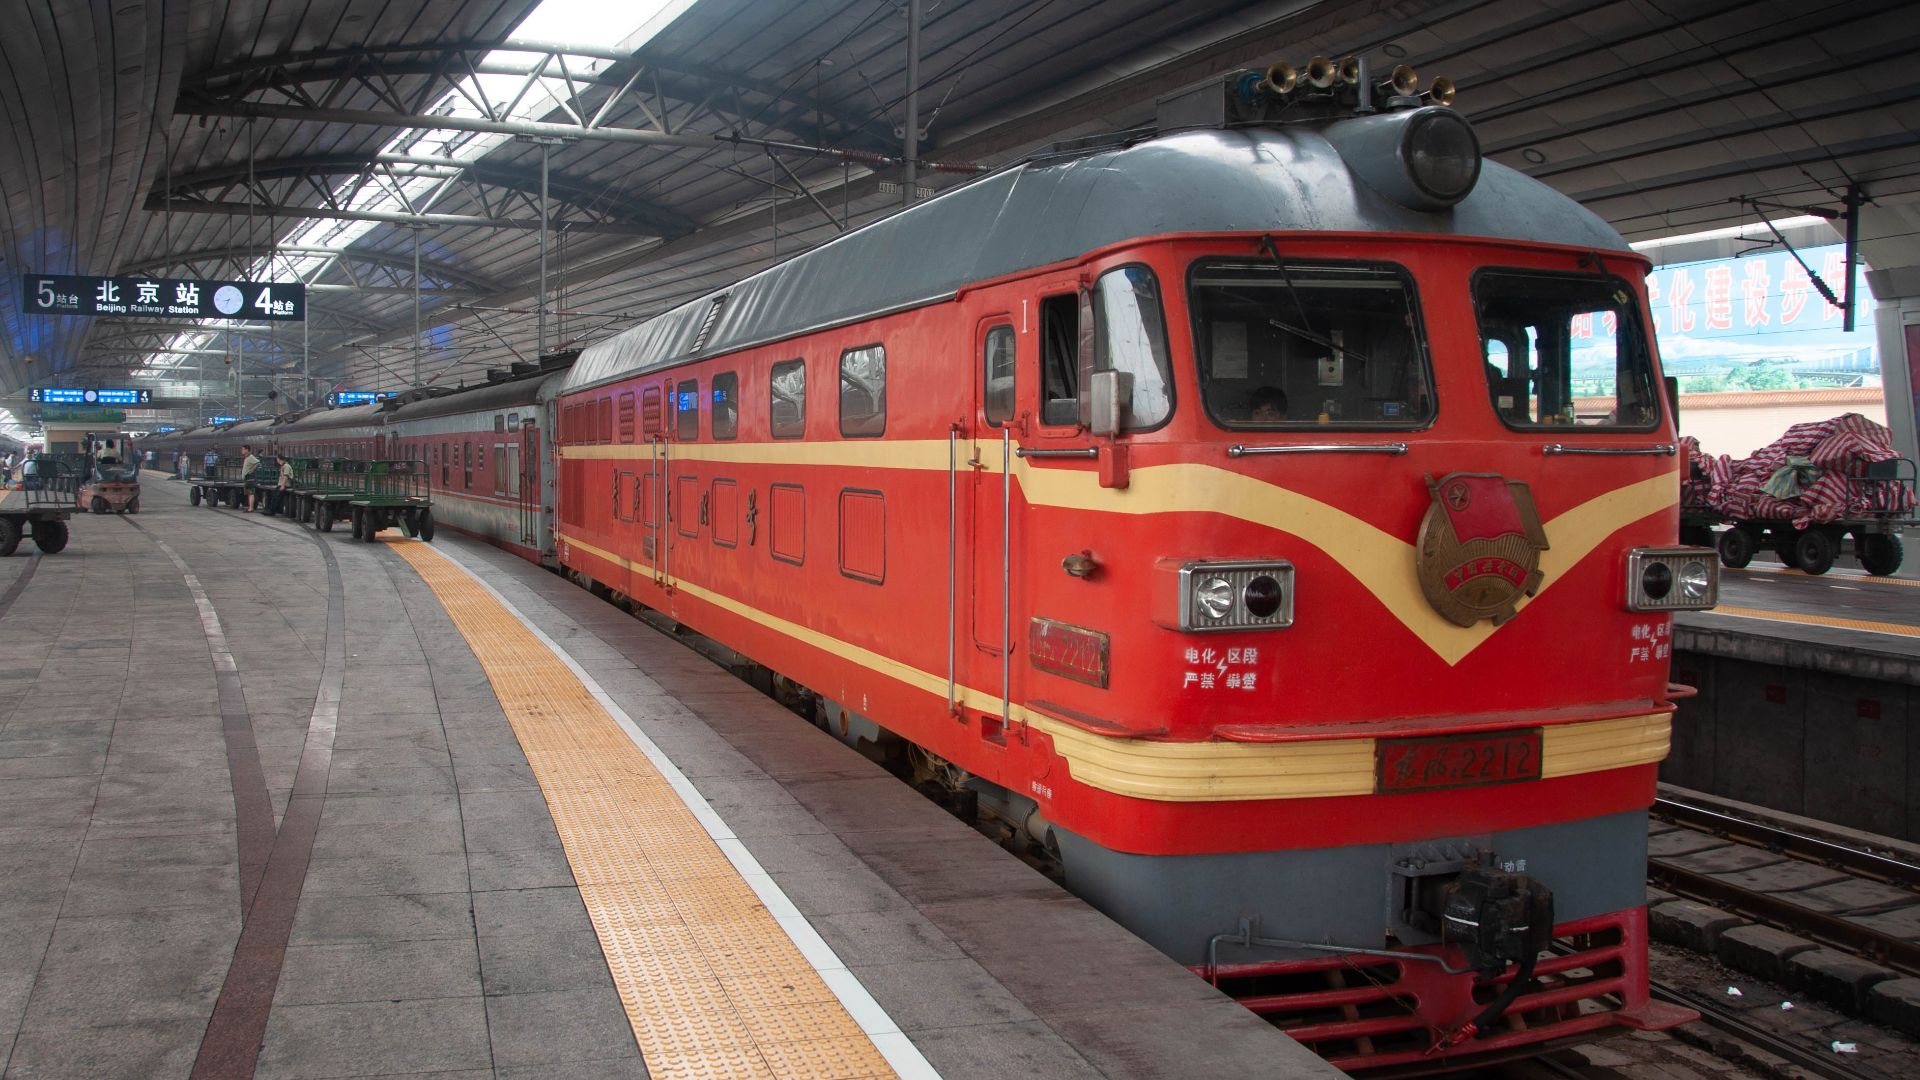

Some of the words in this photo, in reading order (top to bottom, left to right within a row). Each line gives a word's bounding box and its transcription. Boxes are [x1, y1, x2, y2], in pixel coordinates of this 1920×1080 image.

[37, 280, 55, 308] 5
[56, 294, 79, 304] 站台
[96, 280, 200, 305] 北京站
[254, 287, 273, 315] 4
[96, 303, 127, 313] Beijing
[130, 304, 165, 314] Railway
[168, 305, 199, 314] Station
[272, 300, 295, 310] 站台
[1185, 647, 1216, 664] 电化
[1228, 647, 1258, 665] 区段
[1183, 672, 1215, 689] 严禁
[1226, 671, 1257, 690] 攀登
[1462, 742, 1532, 779] 2212
[1499, 859, 1527, 873] 动管
